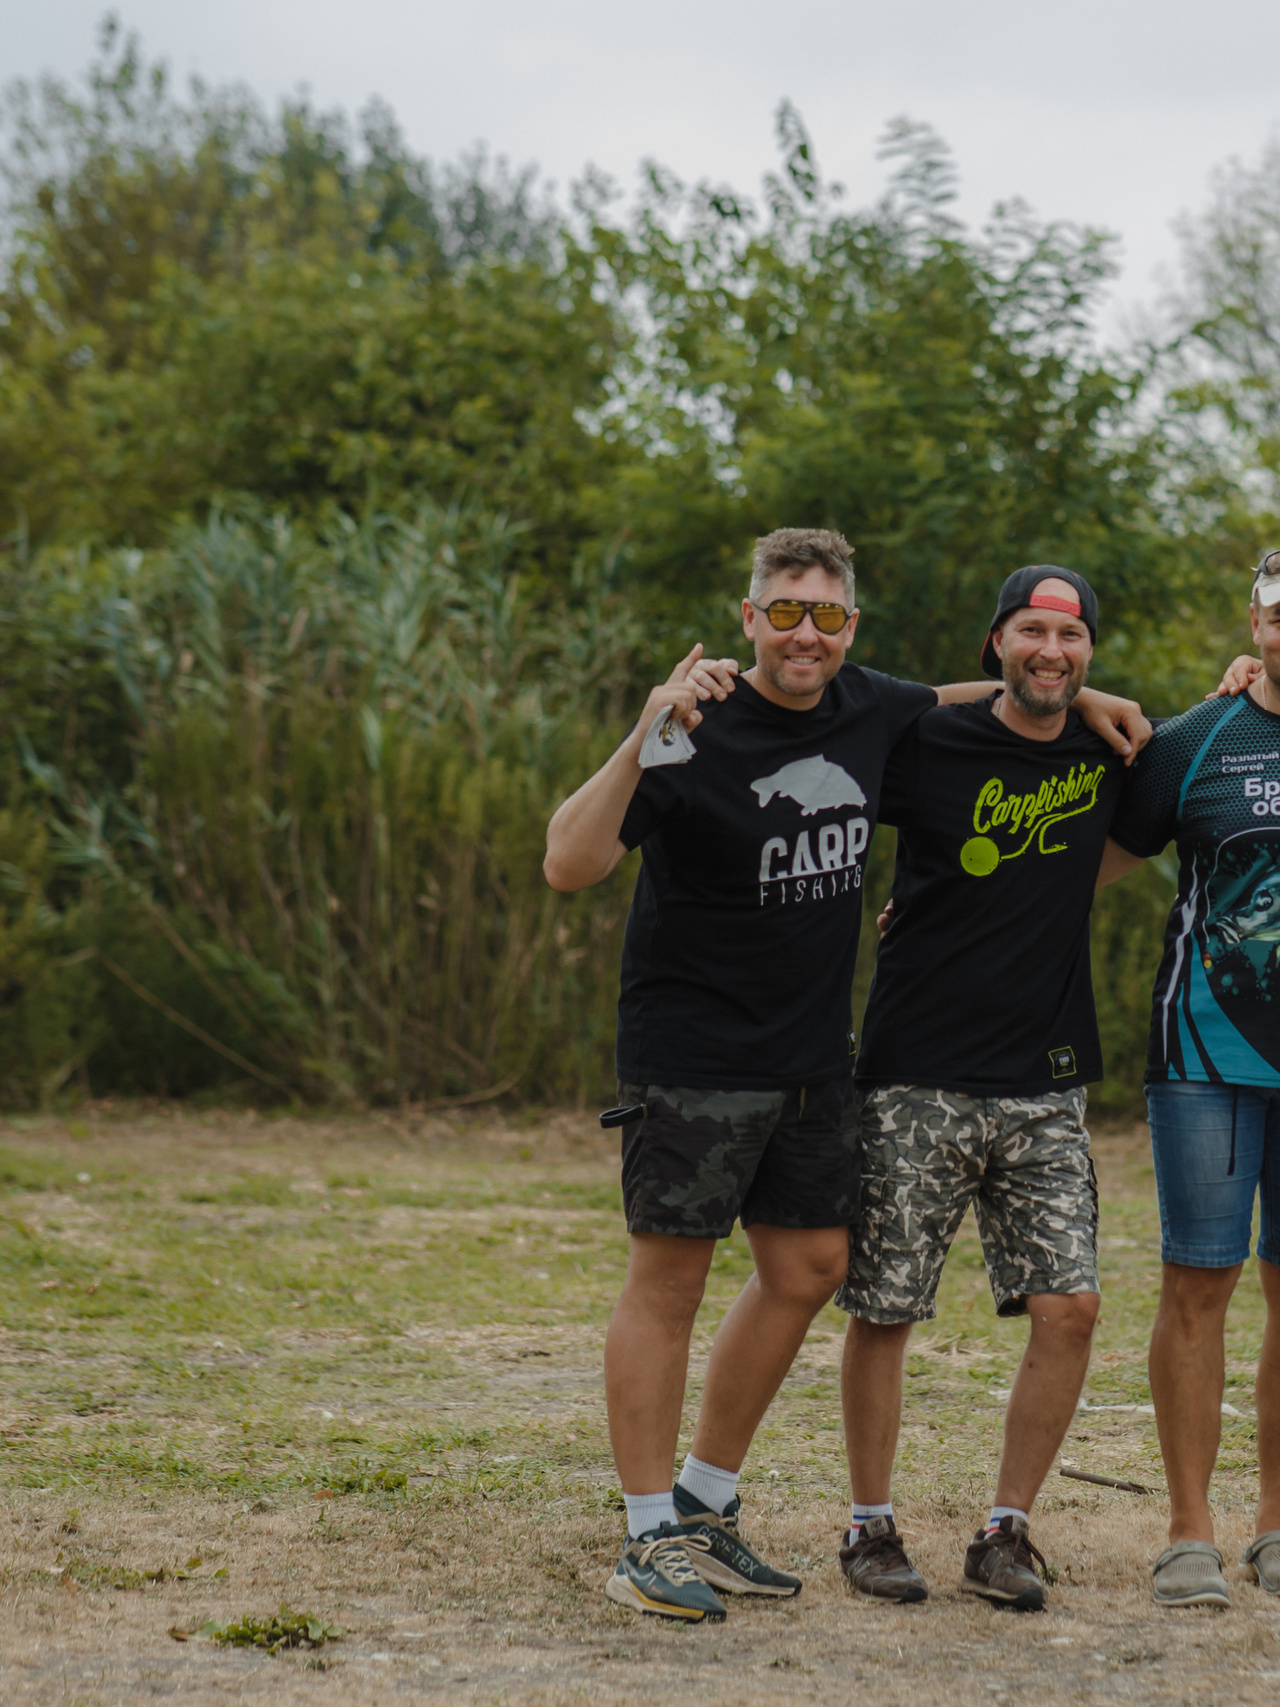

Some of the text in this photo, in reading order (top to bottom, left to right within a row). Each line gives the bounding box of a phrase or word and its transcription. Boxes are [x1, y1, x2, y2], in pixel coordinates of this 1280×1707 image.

[1221, 750, 1280, 764] Разлатый
[1221, 762, 1265, 774] Сергей
[972, 761, 1106, 835] Carpfishing
[759, 816, 870, 884] CARP
[760, 864, 862, 906] FISHING
